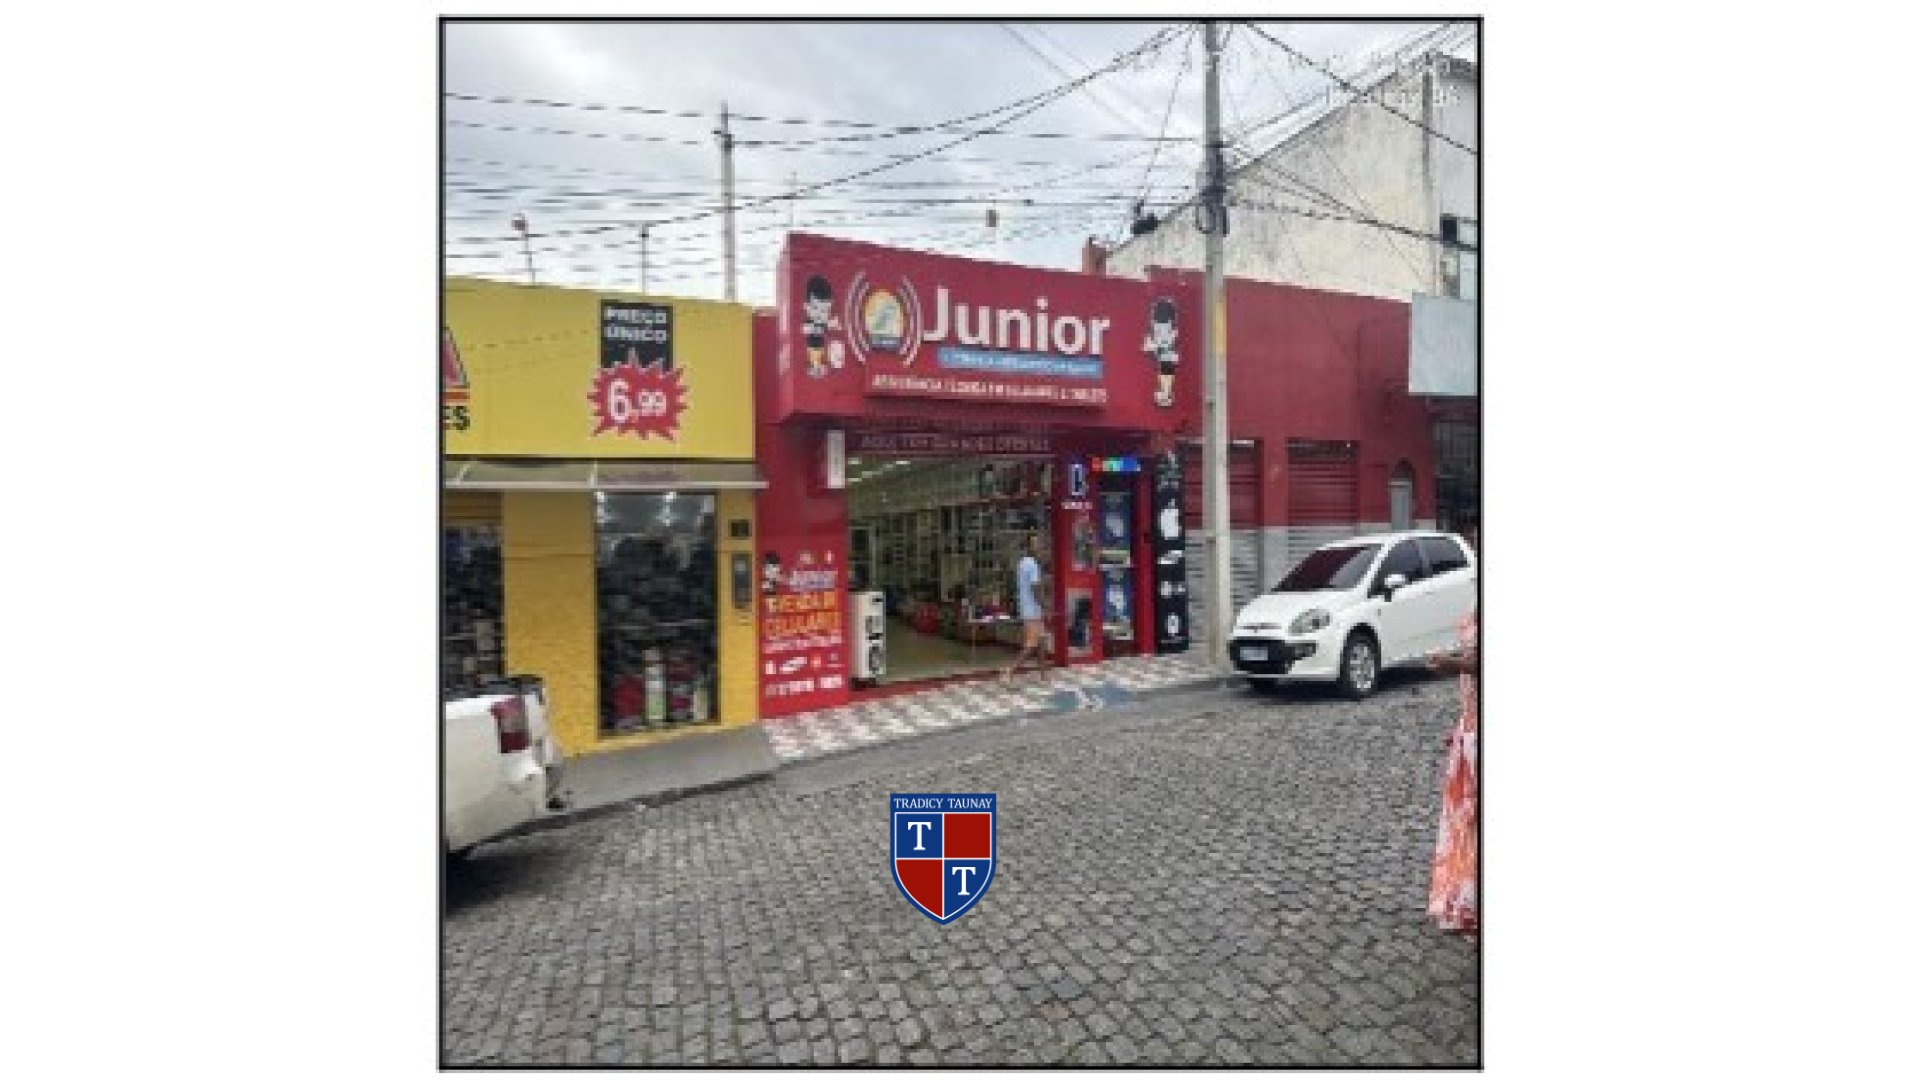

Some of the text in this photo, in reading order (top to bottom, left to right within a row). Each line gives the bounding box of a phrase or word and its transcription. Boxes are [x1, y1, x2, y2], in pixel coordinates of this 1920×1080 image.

[604, 307, 667, 325] PREÇO
[923, 287, 1110, 355] Junior
[604, 324, 667, 343] ÚNICO
[608, 380, 668, 423] 6,99
